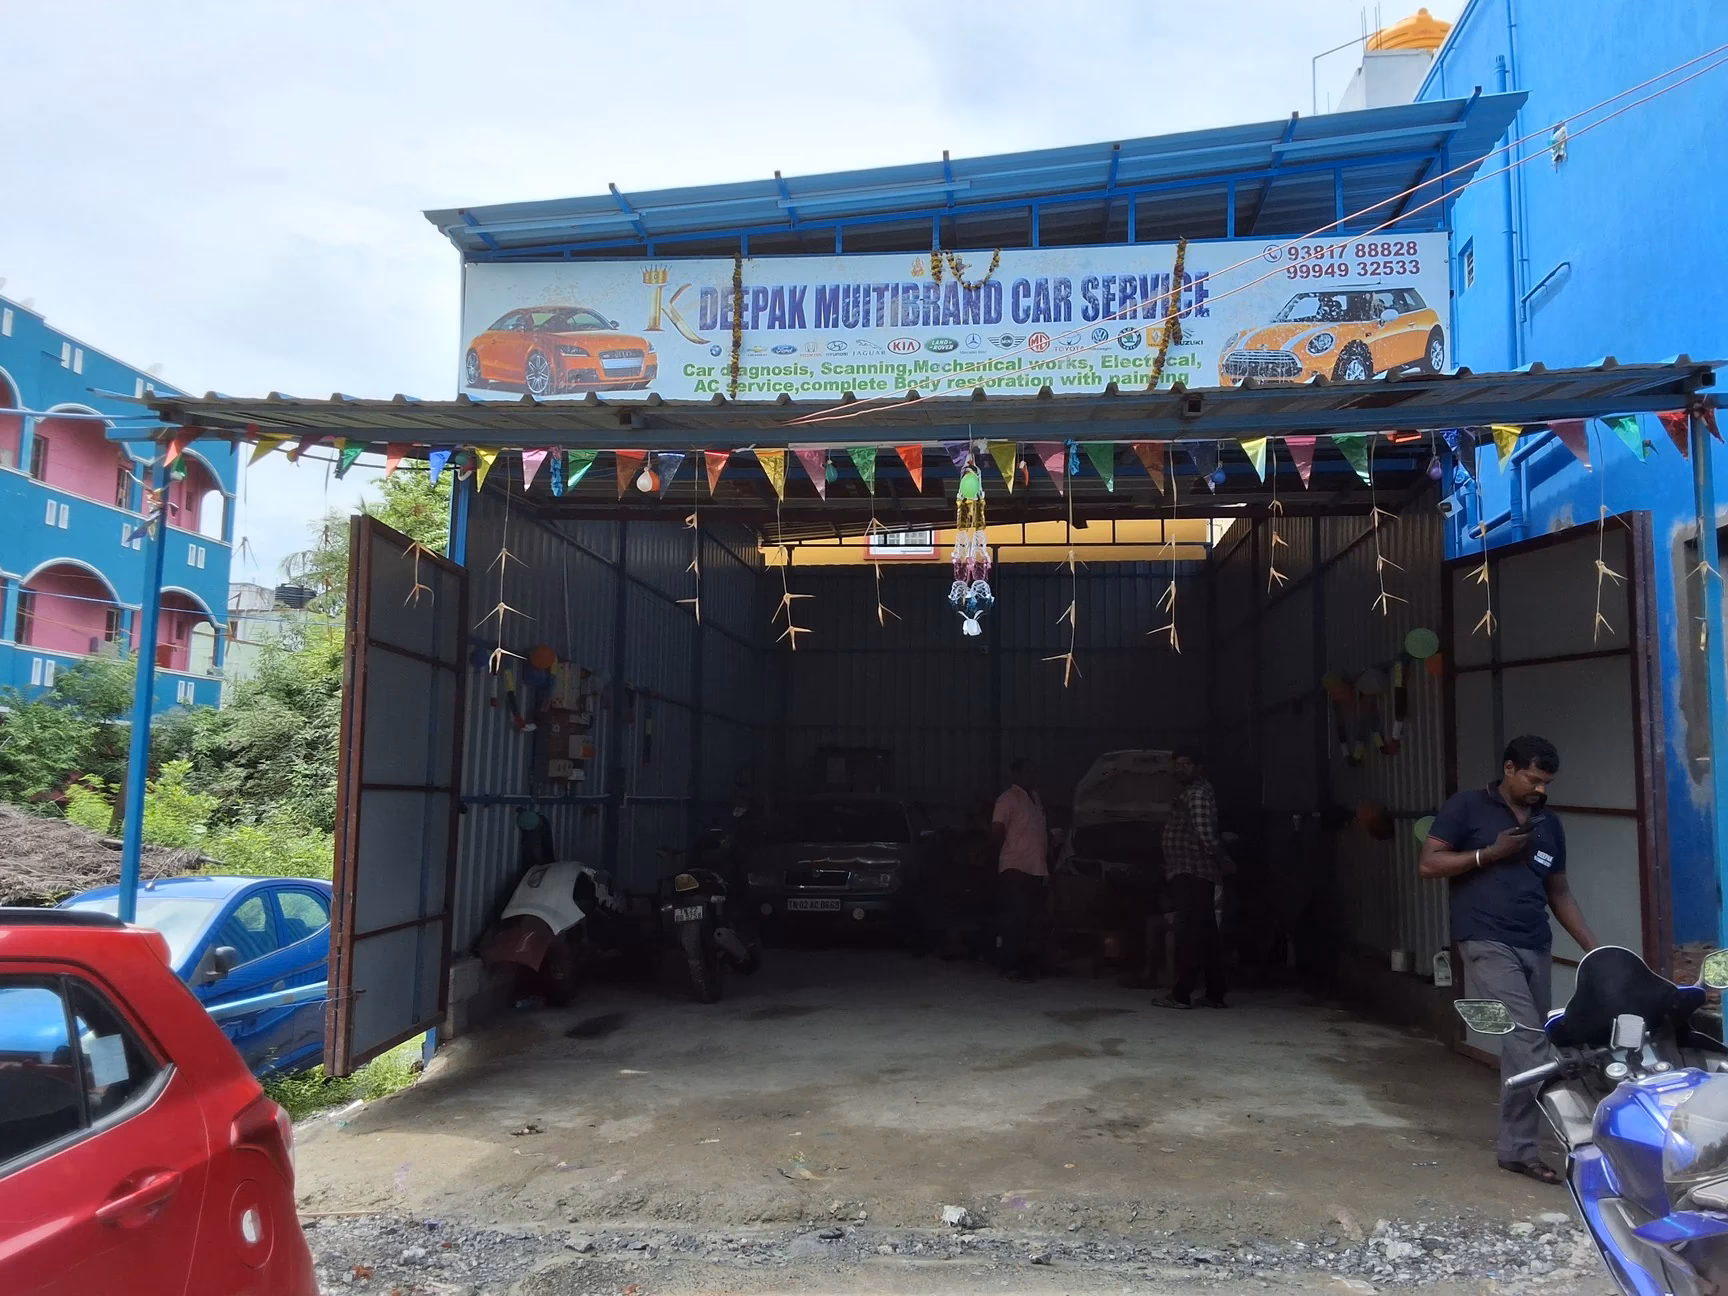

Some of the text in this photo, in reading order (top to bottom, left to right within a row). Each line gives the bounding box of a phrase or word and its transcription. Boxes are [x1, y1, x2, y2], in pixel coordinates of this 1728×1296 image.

[1287, 241, 1418, 261] 93817 88828
[1286, 259, 1421, 280] 99949 32533
[699, 285, 807, 330] DEEPAK
[1011, 277, 1073, 324] CAR
[1080, 271, 1210, 322] SERVICE
[893, 342, 915, 351] KIA
[683, 363, 715, 376] Car
[720, 363, 814, 379] dagnosis,
[1029, 356, 1094, 371] works,
[694, 379, 720, 392] AC
[895, 376, 941, 392] Body
[947, 373, 1053, 389] restoration
[1061, 371, 1102, 385] with
[1109, 370, 1189, 386] paining
